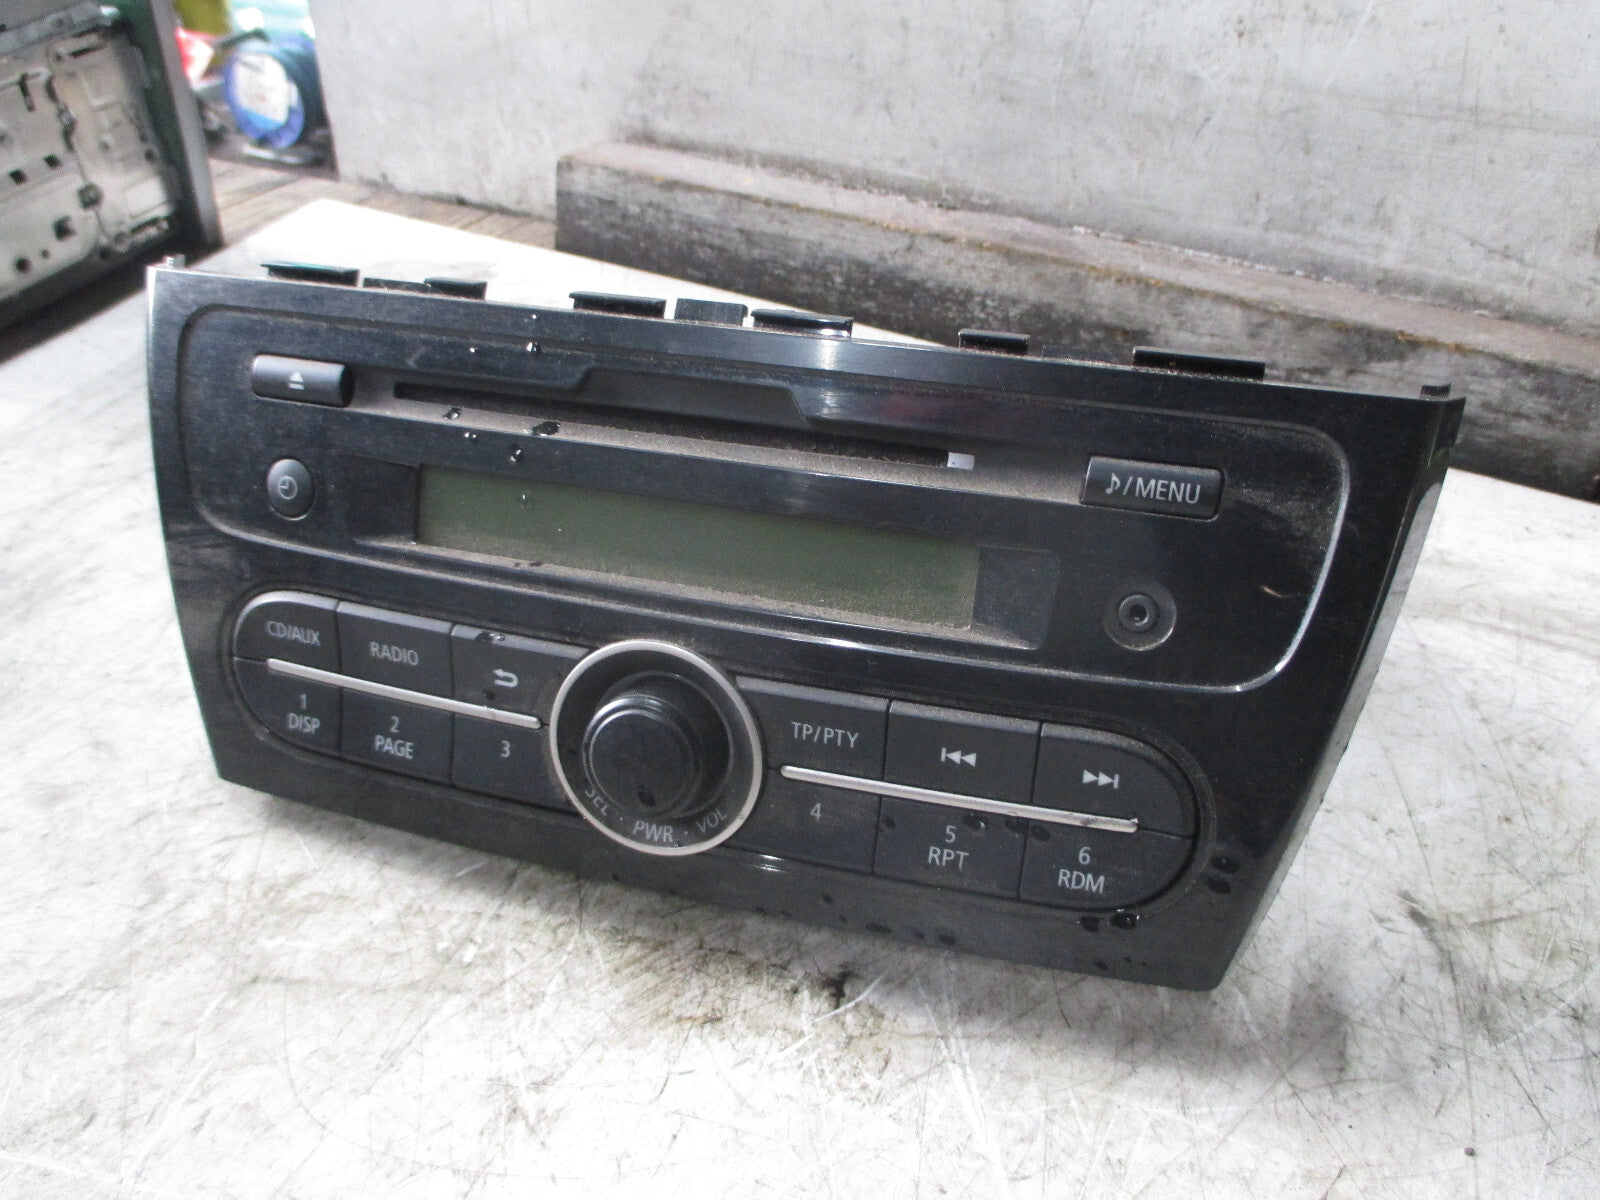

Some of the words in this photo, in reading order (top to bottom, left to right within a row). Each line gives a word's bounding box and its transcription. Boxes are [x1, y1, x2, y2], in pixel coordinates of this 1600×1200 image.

[266, 621, 321, 646] CD/AUX
[369, 641, 419, 666] RADIO
[299, 694, 307, 710] 1
[288, 712, 320, 734] DISP
[390, 716, 399, 733] 2
[791, 721, 859, 748] TP/PTY
[374, 735, 414, 759] PAGE
[501, 740, 511, 758] 3
[809, 802, 822, 821] 4
[633, 820, 674, 842] PWR
[696, 807, 728, 833] VOL
[945, 825, 956, 843] 5
[928, 846, 969, 869] RPT
[1078, 846, 1091, 865] 6
[1057, 868, 1105, 894] RDM
